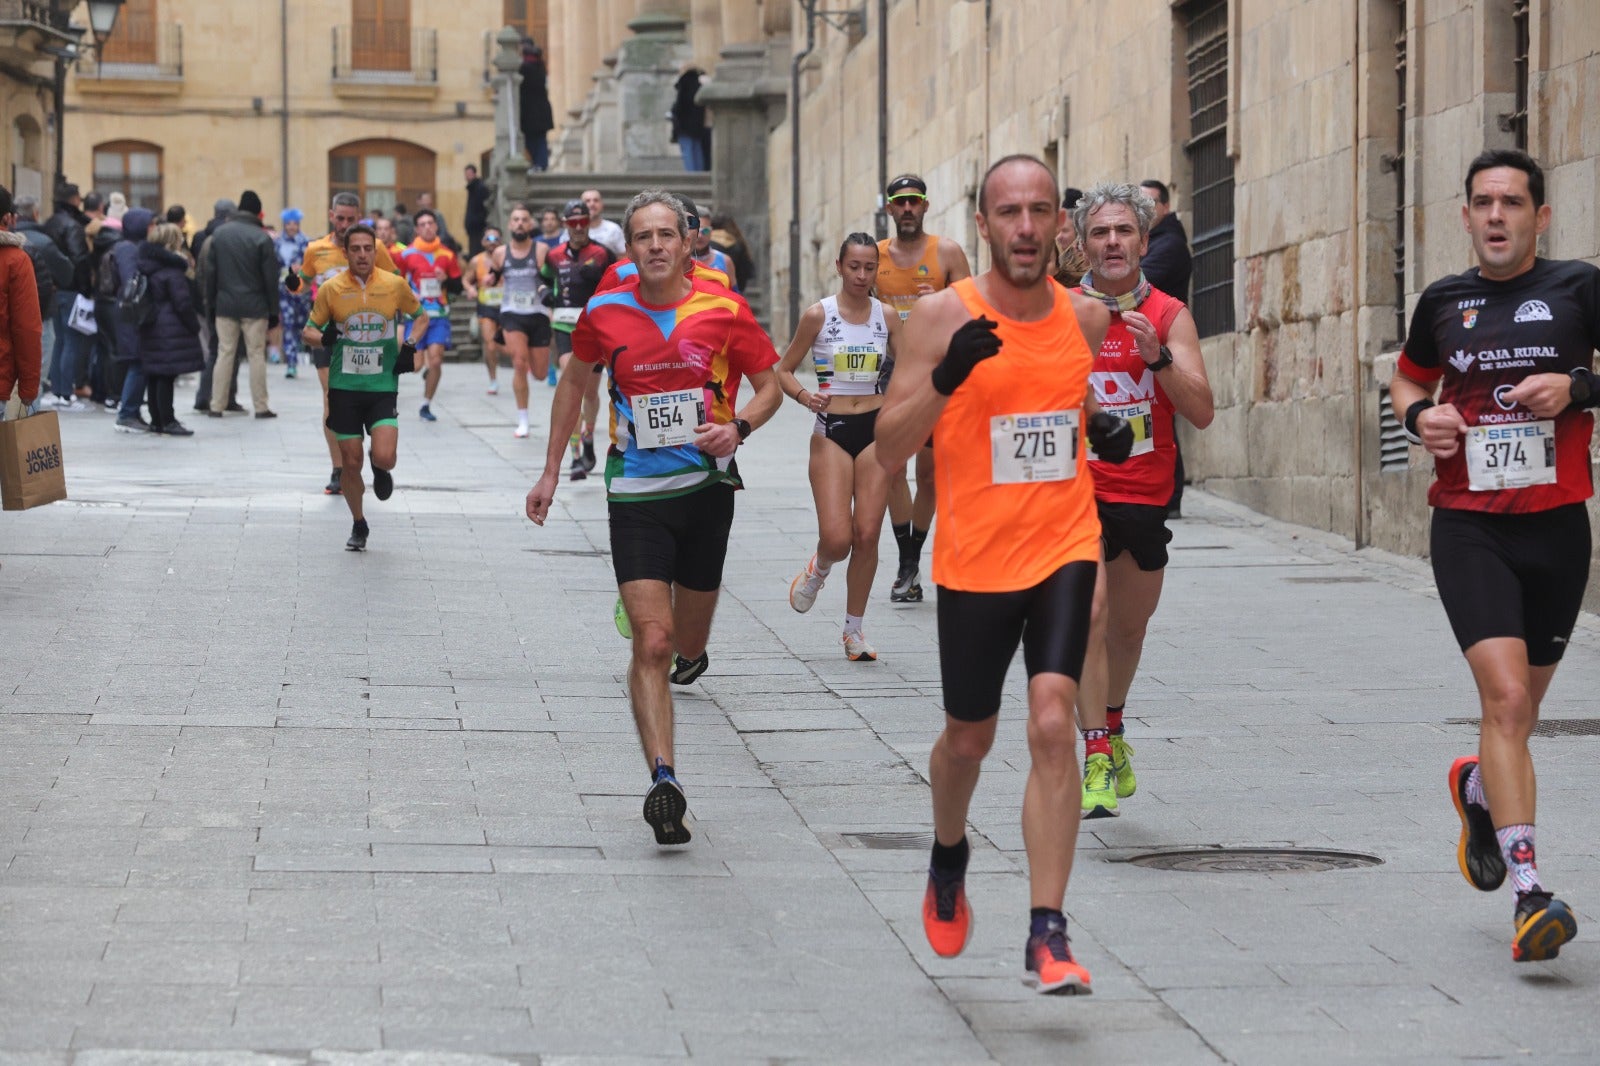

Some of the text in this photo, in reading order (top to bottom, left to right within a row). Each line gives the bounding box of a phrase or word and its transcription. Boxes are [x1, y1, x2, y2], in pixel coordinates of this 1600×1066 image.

[351, 354, 371, 366] 404
[1478, 346, 1559, 361] CAJA RURAL
[645, 362, 671, 371] SILVESTRE
[847, 354, 866, 369] 107
[1480, 360, 1535, 371] DE ZAMORA
[649, 393, 697, 406] SETEL
[648, 405, 684, 429] 654
[1106, 407, 1144, 417] ETEL
[1017, 414, 1072, 428] SETEL
[1488, 426, 1546, 440] SETEL
[1013, 430, 1056, 459] 276
[1485, 441, 1527, 468] 374
[27, 456, 60, 475] JONES
